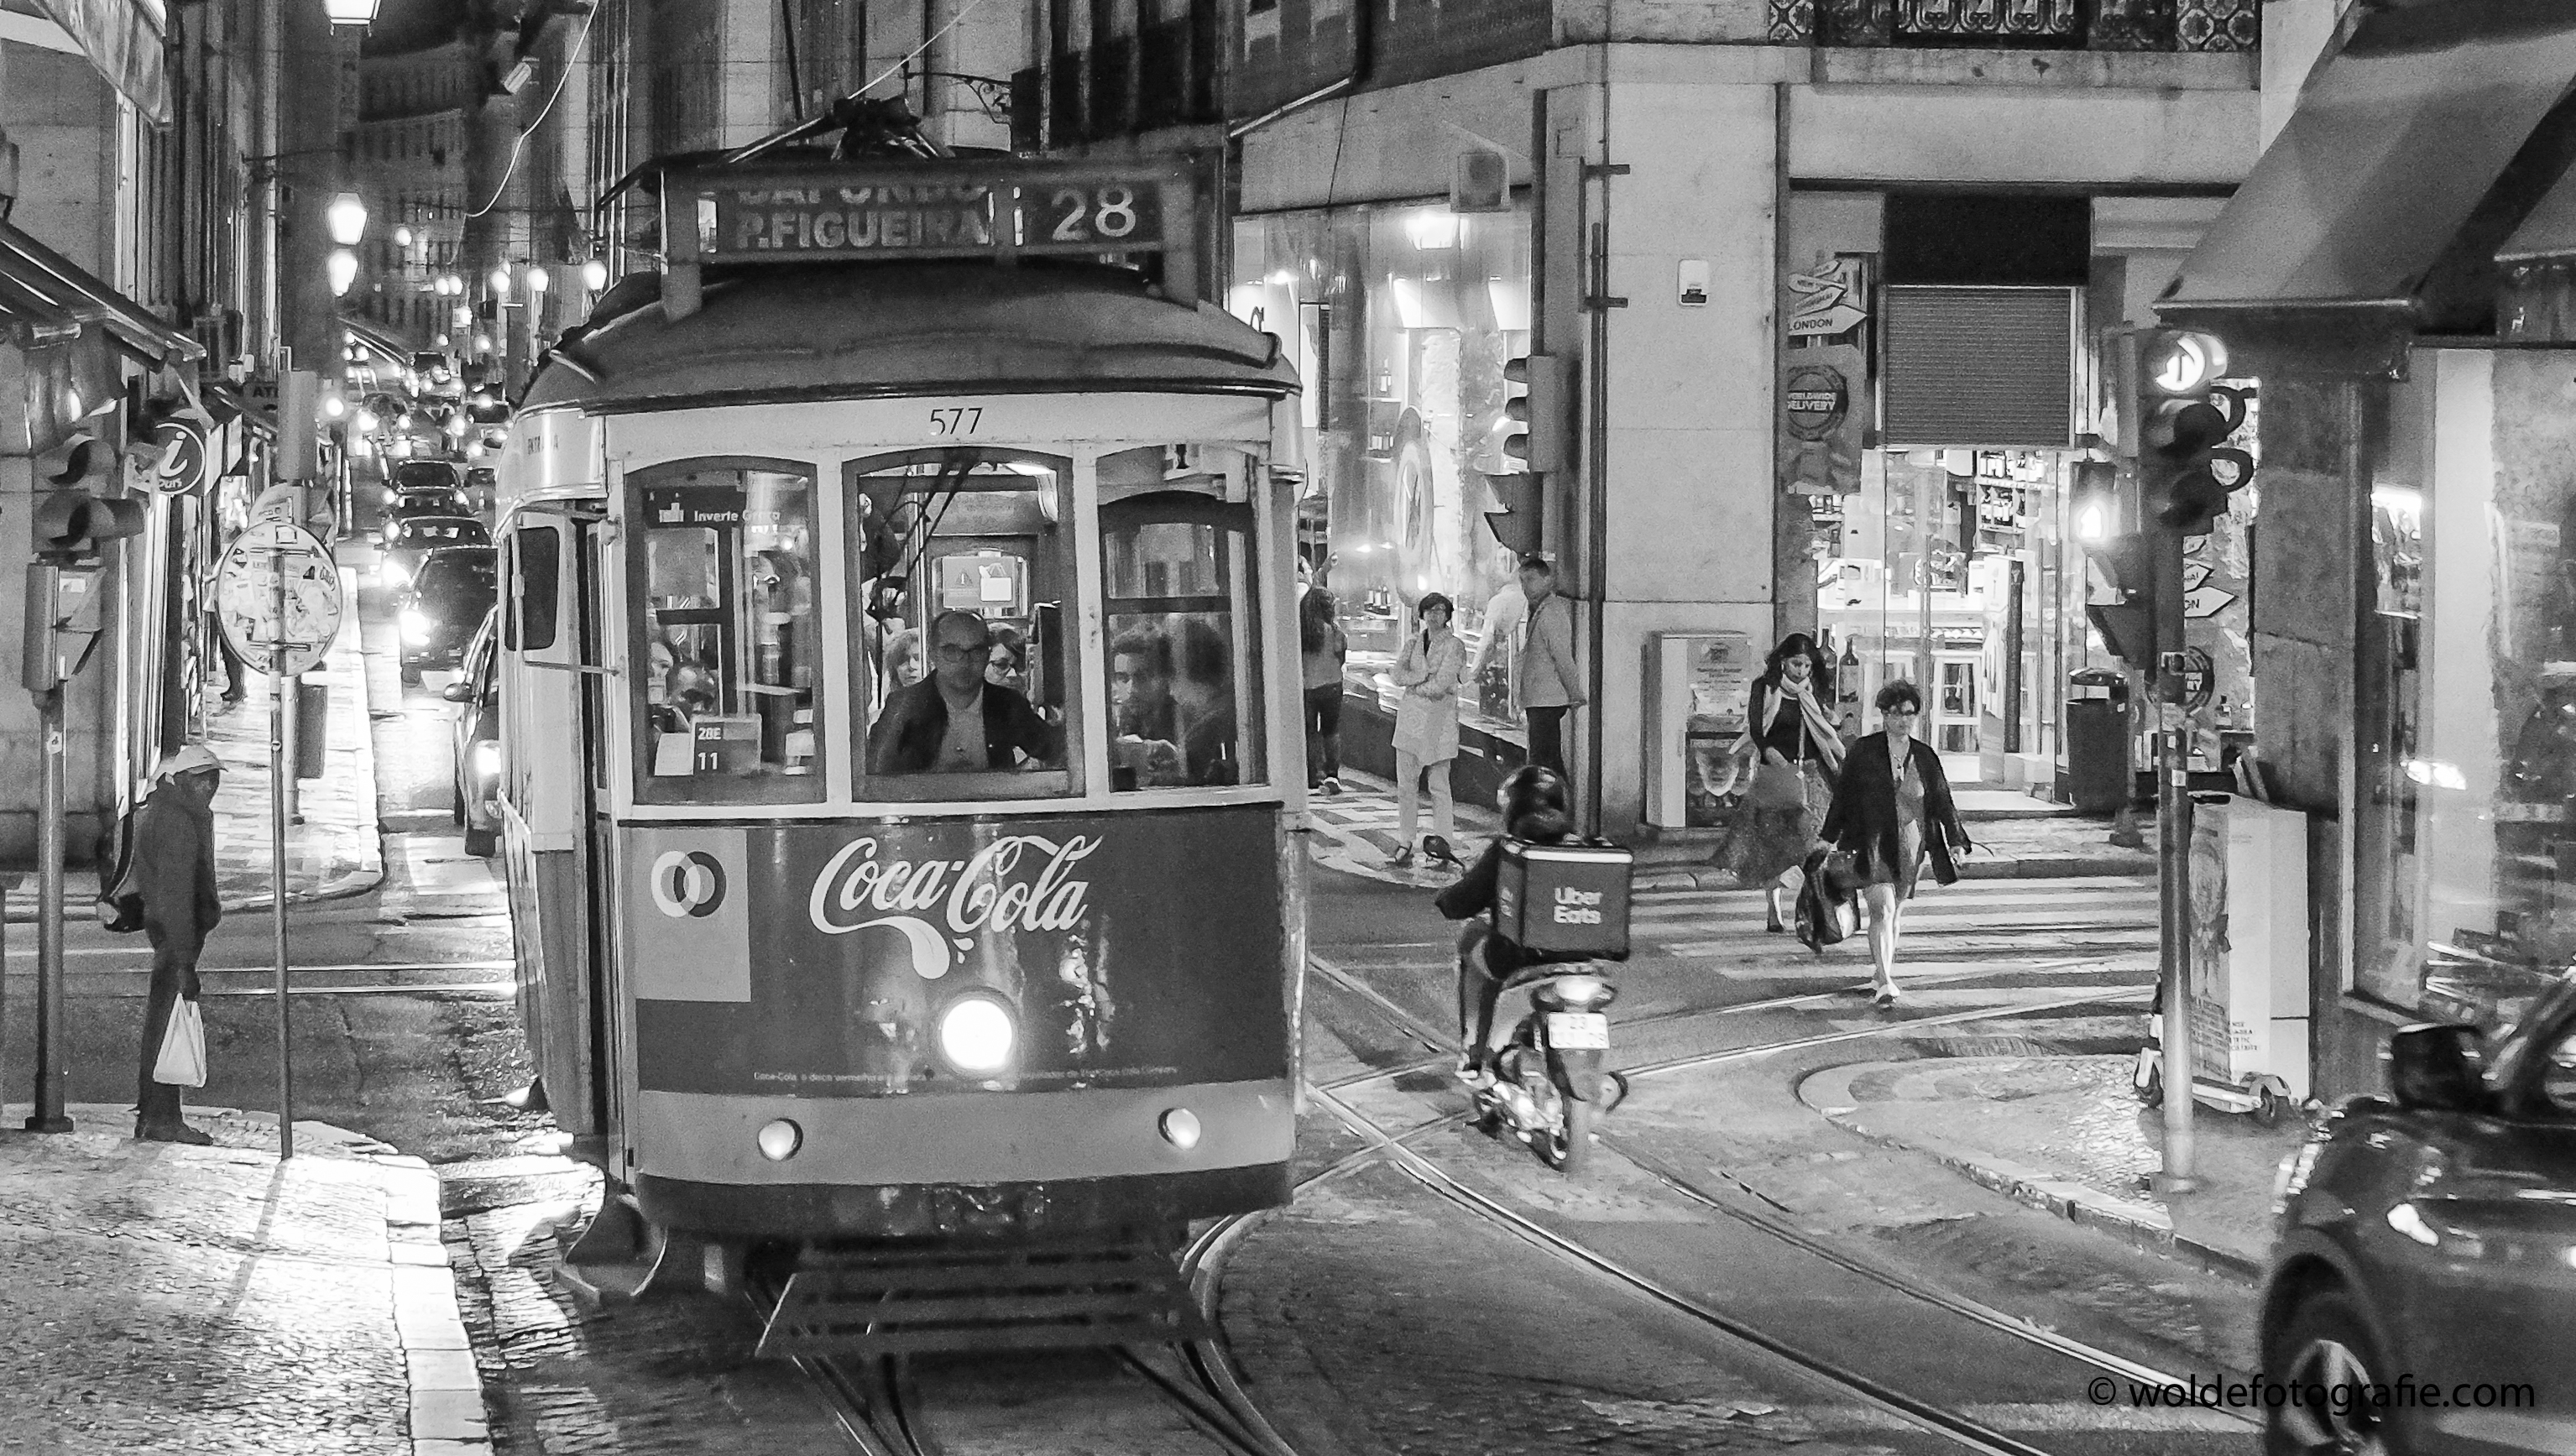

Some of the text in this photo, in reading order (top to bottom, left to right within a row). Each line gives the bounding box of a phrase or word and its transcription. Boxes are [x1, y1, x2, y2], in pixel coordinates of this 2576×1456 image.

[1051, 185, 1136, 241] 28
[930, 407, 983, 436] 577
[698, 752, 718, 770] 11
[809, 835, 1102, 958] Coca-Cola
[1554, 886, 1603, 905] Uber
[1554, 905, 1602, 925] Eats
